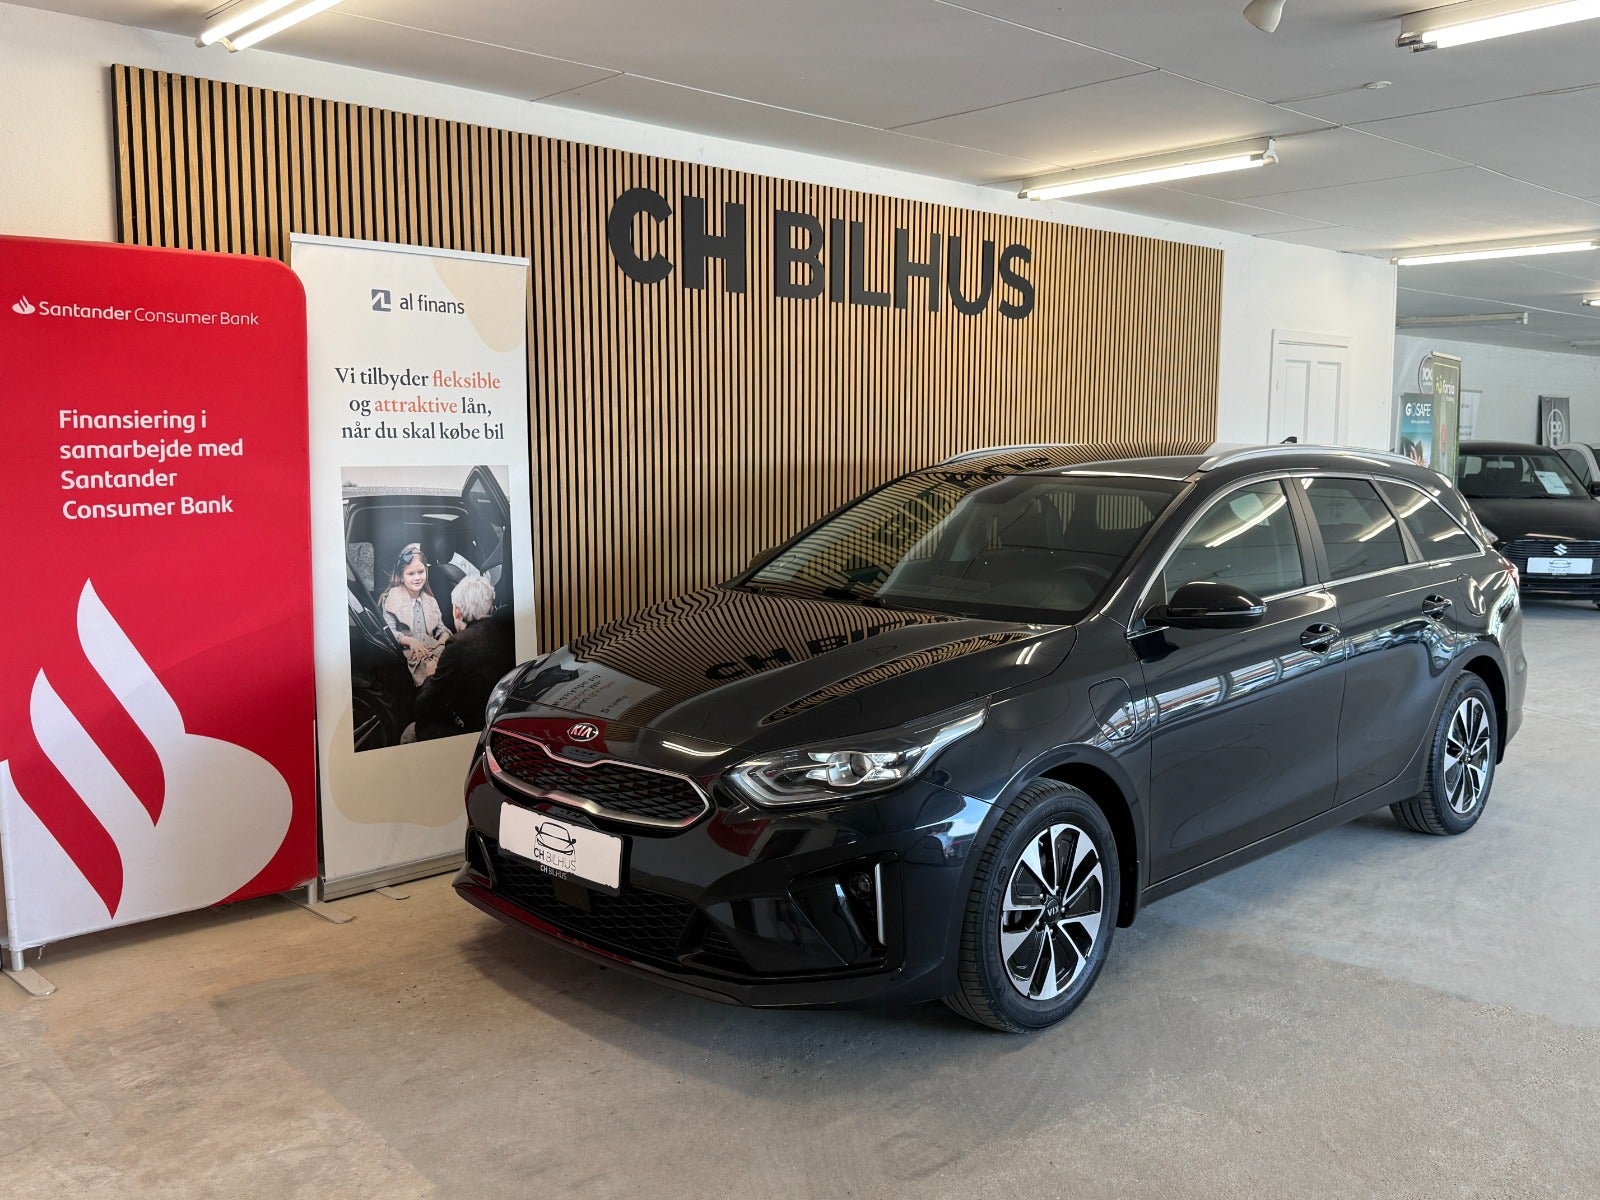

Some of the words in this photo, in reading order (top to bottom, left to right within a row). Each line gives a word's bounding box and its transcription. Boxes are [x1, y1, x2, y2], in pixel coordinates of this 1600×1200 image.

[607, 187, 745, 294] CH
[775, 208, 1035, 320] BILHUS
[38, 301, 132, 321] Santander
[134, 307, 217, 325] Consumer
[220, 312, 259, 326] Bank
[399, 293, 413, 311] al
[418, 294, 465, 315] finans
[334, 367, 355, 384] Vi
[360, 367, 429, 391] tilbyder
[432, 369, 501, 389] fleksible
[349, 399, 371, 417] og
[374, 395, 458, 414] attraktive
[461, 397, 492, 417] lån,
[59, 409, 196, 434] Finansiering
[201, 410, 207, 429] i
[341, 421, 371, 440] når
[374, 421, 398, 440] du
[402, 421, 436, 440] skal
[439, 422, 480, 441] købe
[484, 422, 505, 440] bil
[59, 439, 192, 463] samarbejde
[198, 438, 243, 457] med
[61, 469, 178, 490] Santander
[62, 499, 176, 520] Consumer
[180, 495, 234, 515] Bank
[570, 724, 594, 739] KIA
[533, 847, 545, 861] CH
[546, 851, 577, 872] BILHUS
[540, 864, 548, 874] CH
[548, 867, 568, 880] BILHUS
